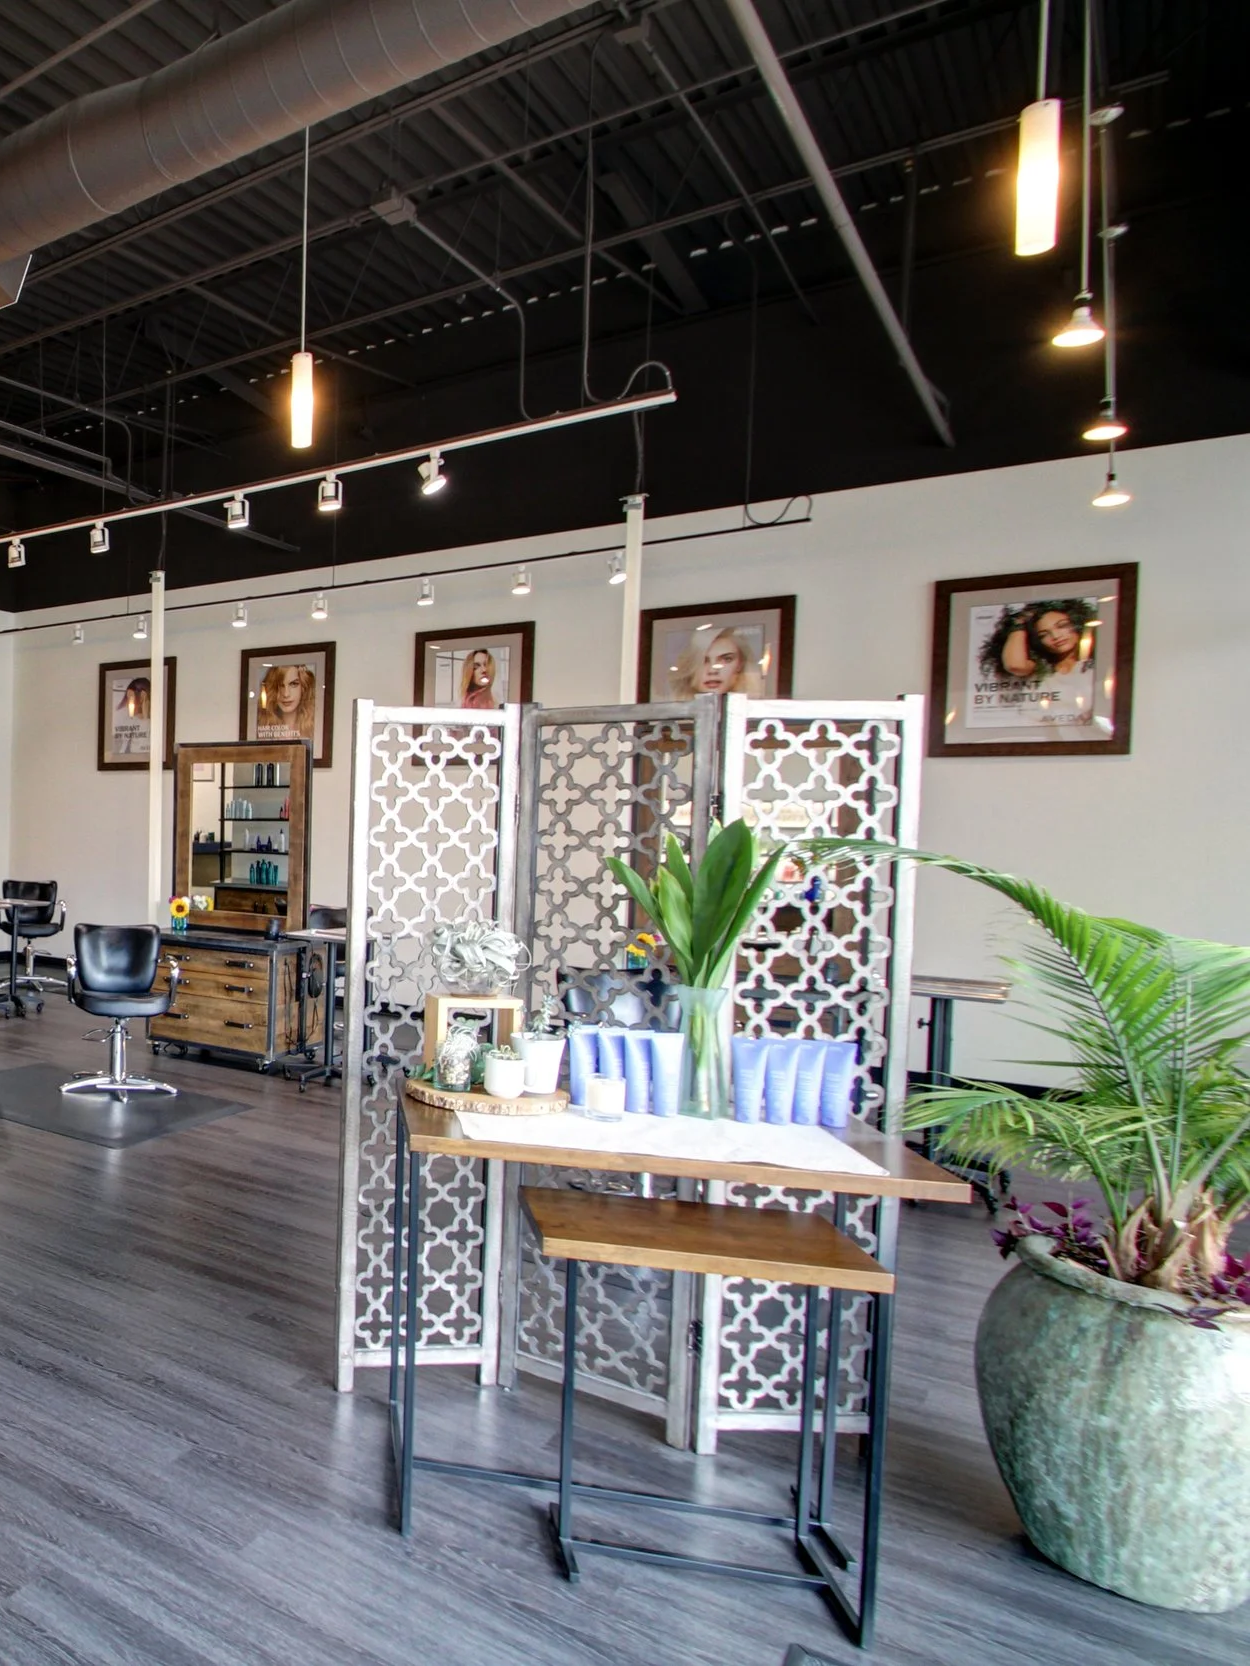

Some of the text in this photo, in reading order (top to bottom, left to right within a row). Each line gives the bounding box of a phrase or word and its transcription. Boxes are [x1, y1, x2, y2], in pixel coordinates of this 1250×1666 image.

[974, 680, 1042, 693] VIBRANT
[974, 691, 1062, 705] BY NATURE
[274, 730, 301, 738] BENEFITS
